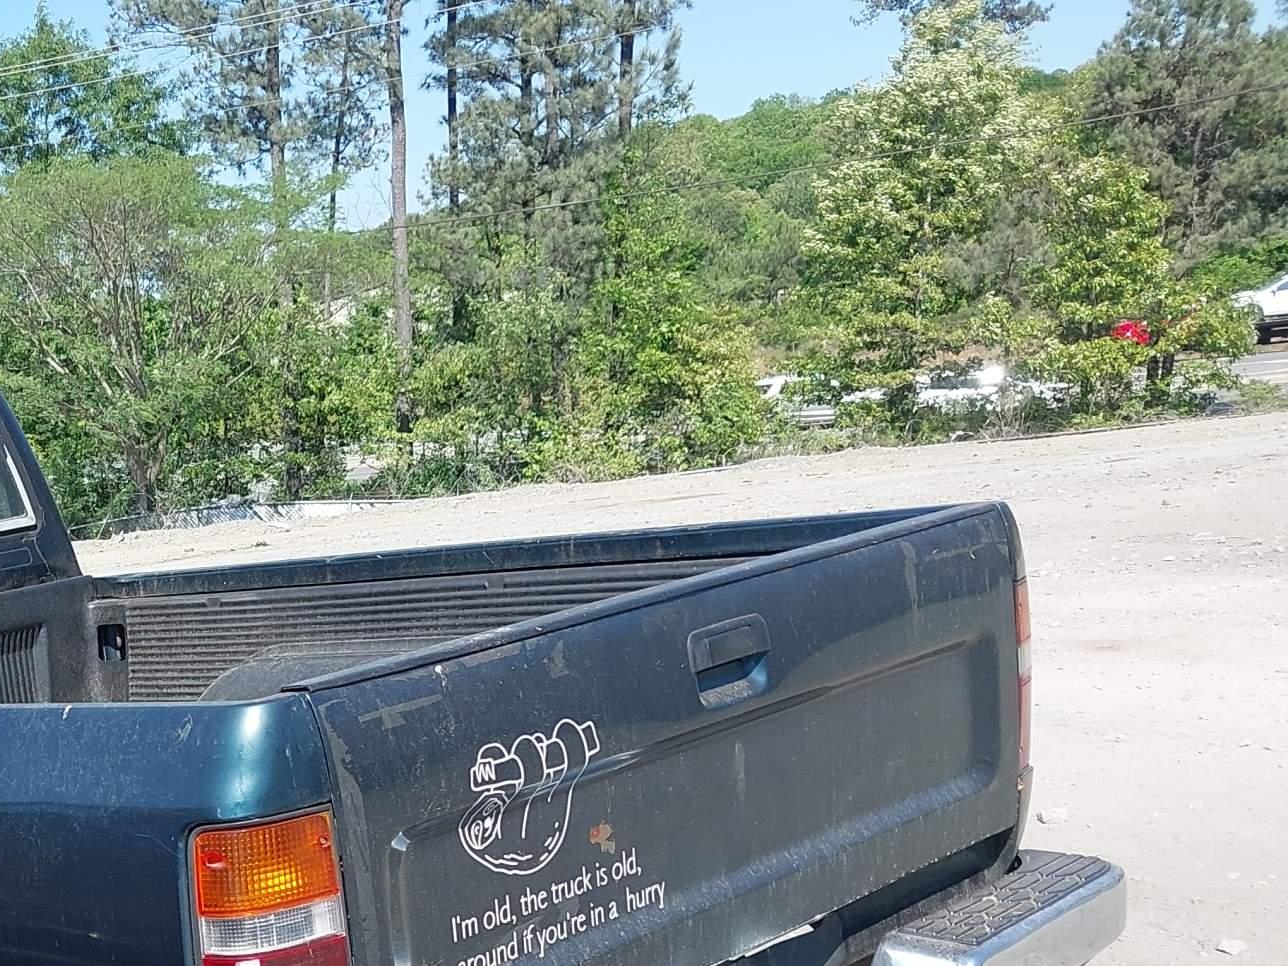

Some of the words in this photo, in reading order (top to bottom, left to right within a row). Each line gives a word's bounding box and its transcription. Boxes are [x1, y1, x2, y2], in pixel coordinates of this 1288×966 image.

[451, 915, 479, 943] I'm
[483, 895, 517, 930] old,
[520, 887, 548, 917] the
[551, 865, 593, 905] truck
[595, 862, 608, 887] is
[612, 847, 642, 881] old,
[522, 925, 535, 954] if
[536, 912, 587, 958] you're
[590, 903, 605, 928] in
[608, 902, 619, 919] a
[626, 881, 666, 913] hurry
